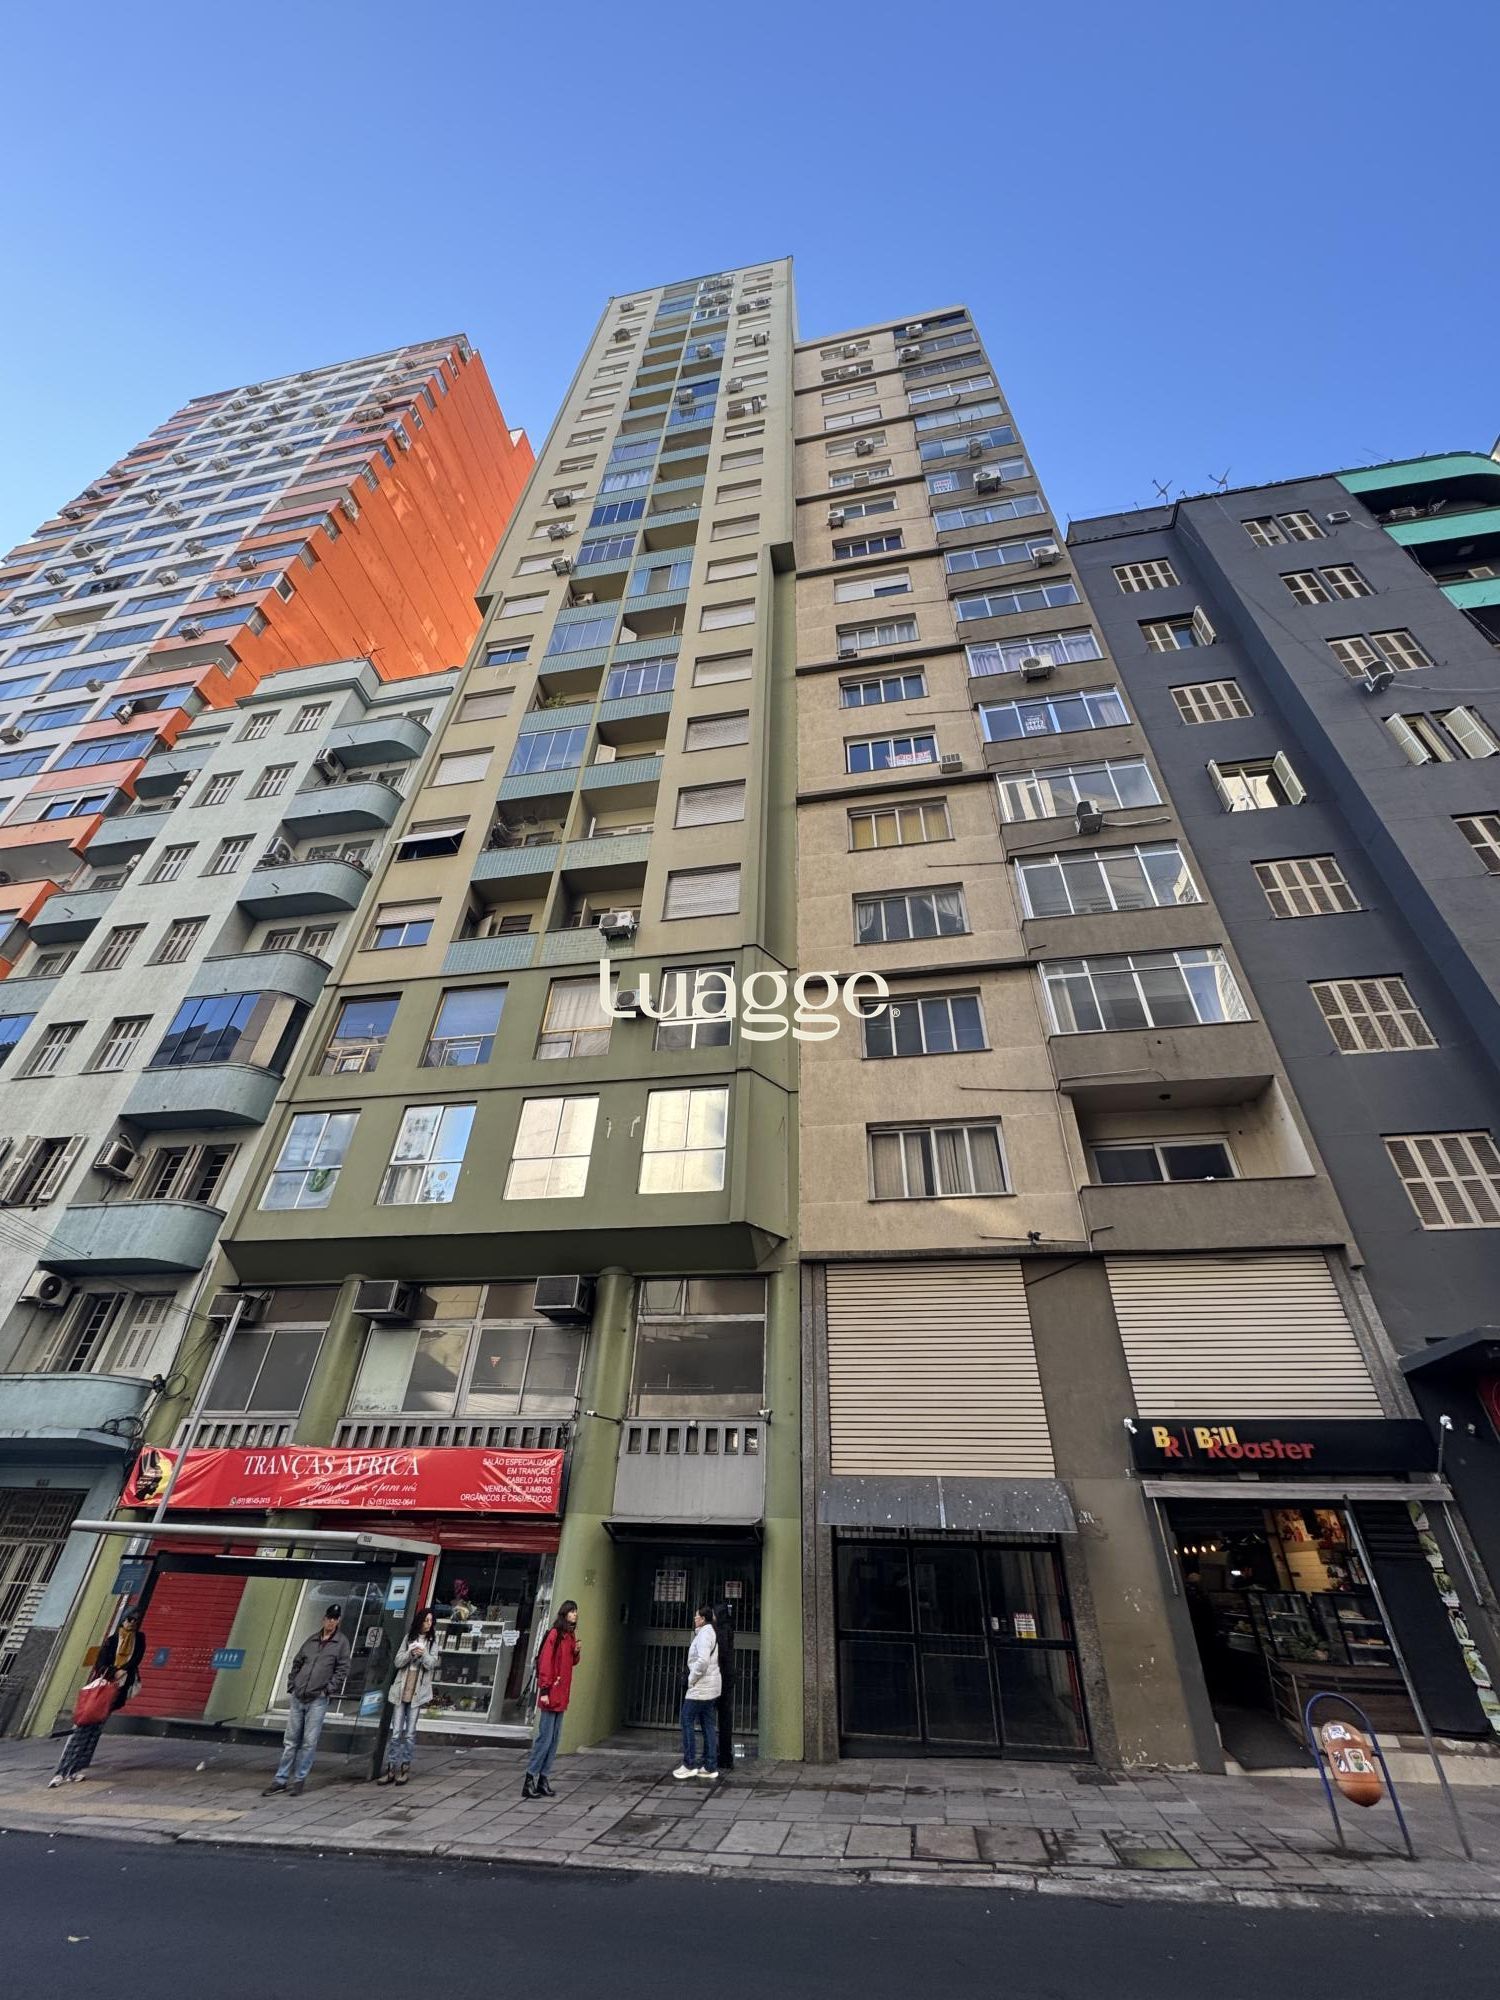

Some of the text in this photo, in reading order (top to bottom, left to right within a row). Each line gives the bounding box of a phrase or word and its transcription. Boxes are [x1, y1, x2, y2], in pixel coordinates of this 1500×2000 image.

[1193, 1426, 1239, 1449] Bill
[1207, 1438, 1315, 1459] Roaster
[482, 1457, 557, 1466] SALÃO ESPECIALIZADO
[243, 1454, 335, 1479] TRANÇAS
[506, 1467, 517, 1475] EM
[519, 1467, 550, 1476] TRANÇAS
[506, 1476, 533, 1484] CABELO
[484, 1485, 512, 1493] VENDAS
[512, 1485, 523, 1493] DE
[460, 1493, 500, 1502] ORGÂNICOS
[501, 1494, 506, 1502] E
